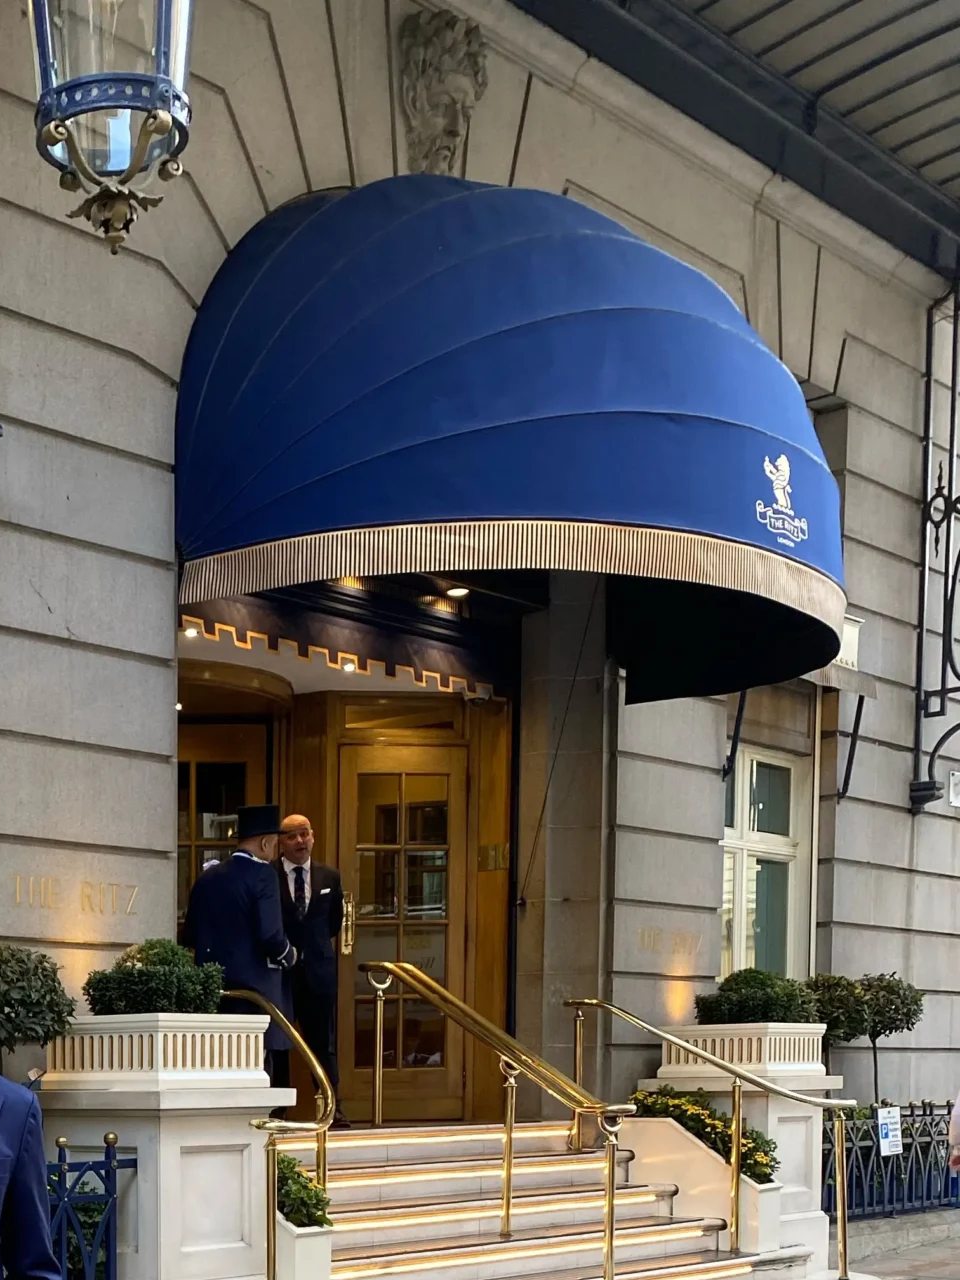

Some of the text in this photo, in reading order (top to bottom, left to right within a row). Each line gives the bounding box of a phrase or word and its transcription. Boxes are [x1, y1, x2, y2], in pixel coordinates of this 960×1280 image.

[770, 518, 798, 536] THE RITZ
[11, 873, 138, 916] THE RITZ
